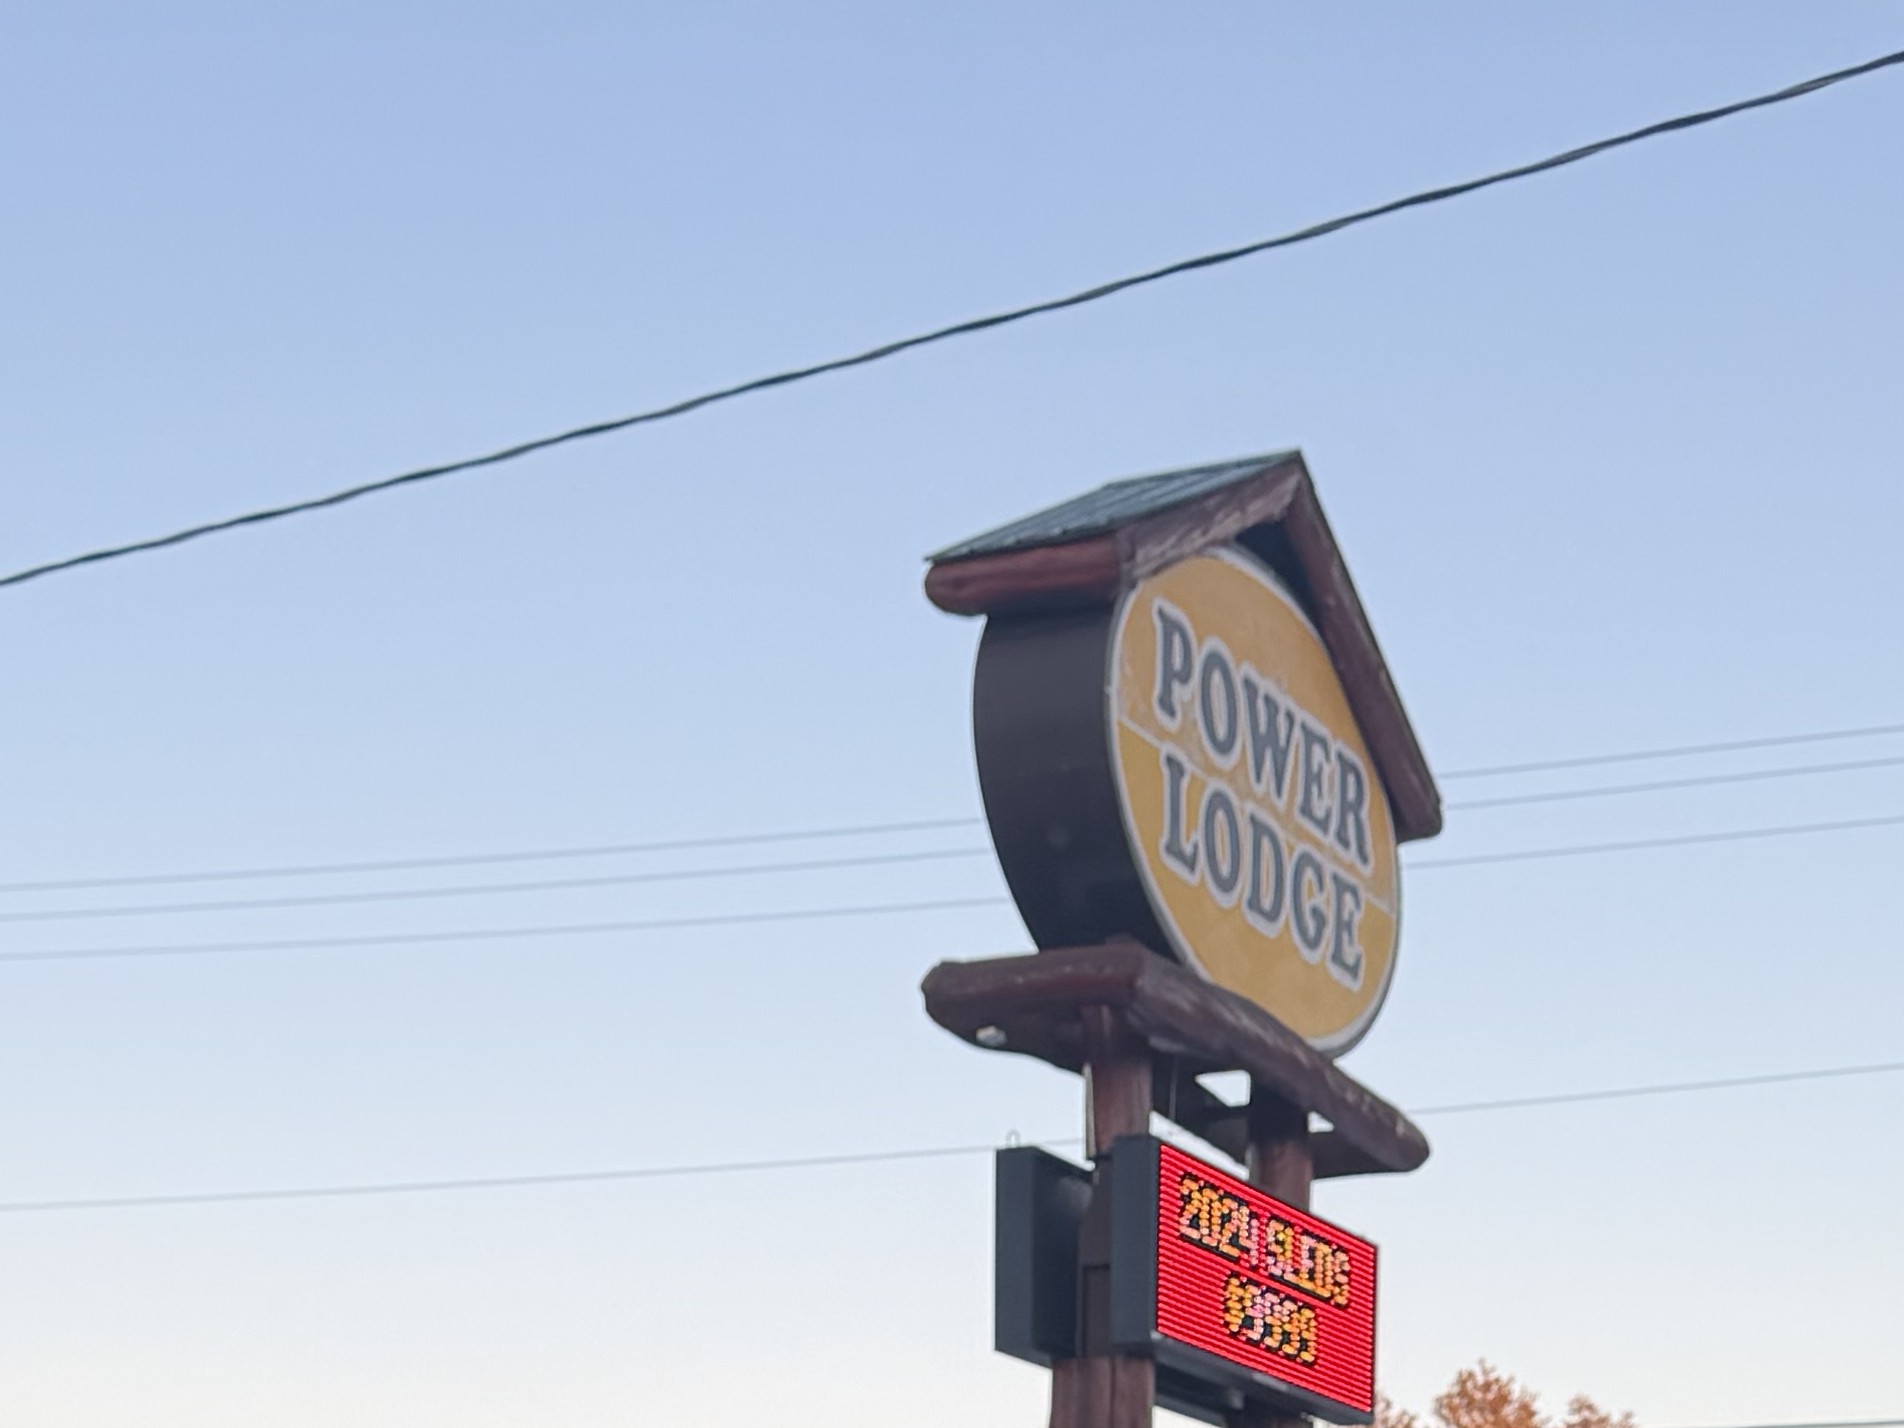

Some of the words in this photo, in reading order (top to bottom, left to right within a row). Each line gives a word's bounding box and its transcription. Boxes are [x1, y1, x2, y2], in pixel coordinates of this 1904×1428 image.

[1154, 602, 1372, 869] POWER
[1160, 750, 1364, 987] LODGE
[1179, 1173, 1260, 1270] 2024
[1265, 1214, 1351, 1309] SLEDS
